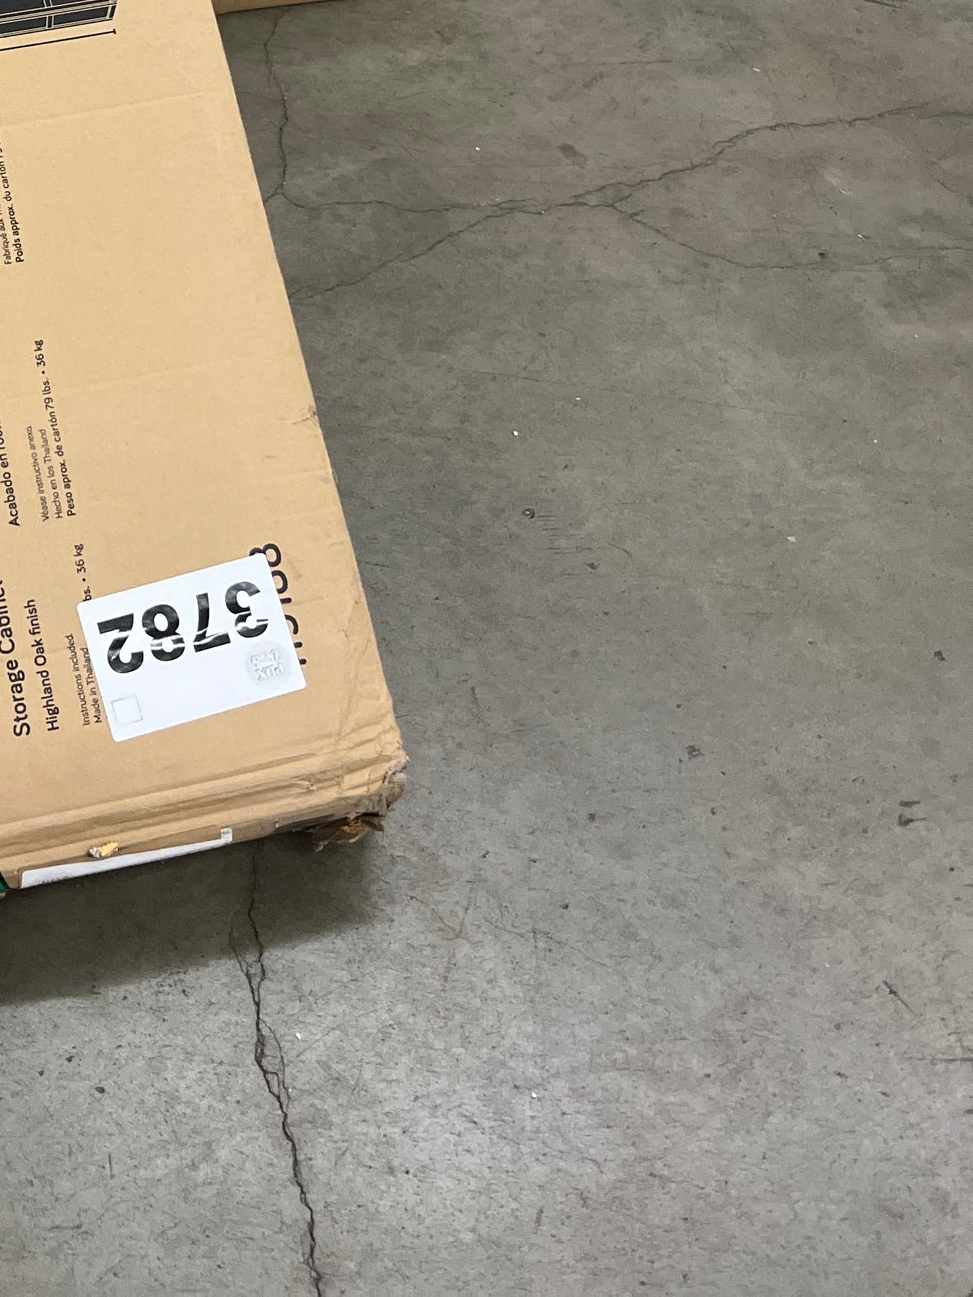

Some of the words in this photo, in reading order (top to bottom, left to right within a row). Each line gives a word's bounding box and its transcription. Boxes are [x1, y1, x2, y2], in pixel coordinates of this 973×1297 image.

[0, 161, 9, 189] carton
[3, 190, 12, 202] du
[0, 232, 12, 265] Fabriqué
[12, 237, 24, 263] Poids
[34, 339, 44, 352] kg
[36, 352, 46, 367] 36
[44, 397, 55, 411] 79
[48, 412, 62, 442] cartón
[54, 444, 64, 457] de
[47, 465, 55, 479] los
[0, 471, 21, 527] Acabado
[49, 480, 58, 492] en
[52, 492, 63, 519] Hecho
[66, 491, 76, 517] Peso
[74, 543, 84, 557] kg
[76, 559, 86, 574] 36
[83, 586, 92, 602] bs.
[24, 599, 42, 635] finish
[96, 581, 269, 674] 3782
[30, 638, 47, 667] Oak
[81, 647, 95, 687] Thailand
[6, 659, 31, 737] Storage
[36, 671, 59, 732] Highland
[74, 674, 90, 726] Instructions
[86, 687, 95, 699] in
[88, 700, 102, 723] Made
